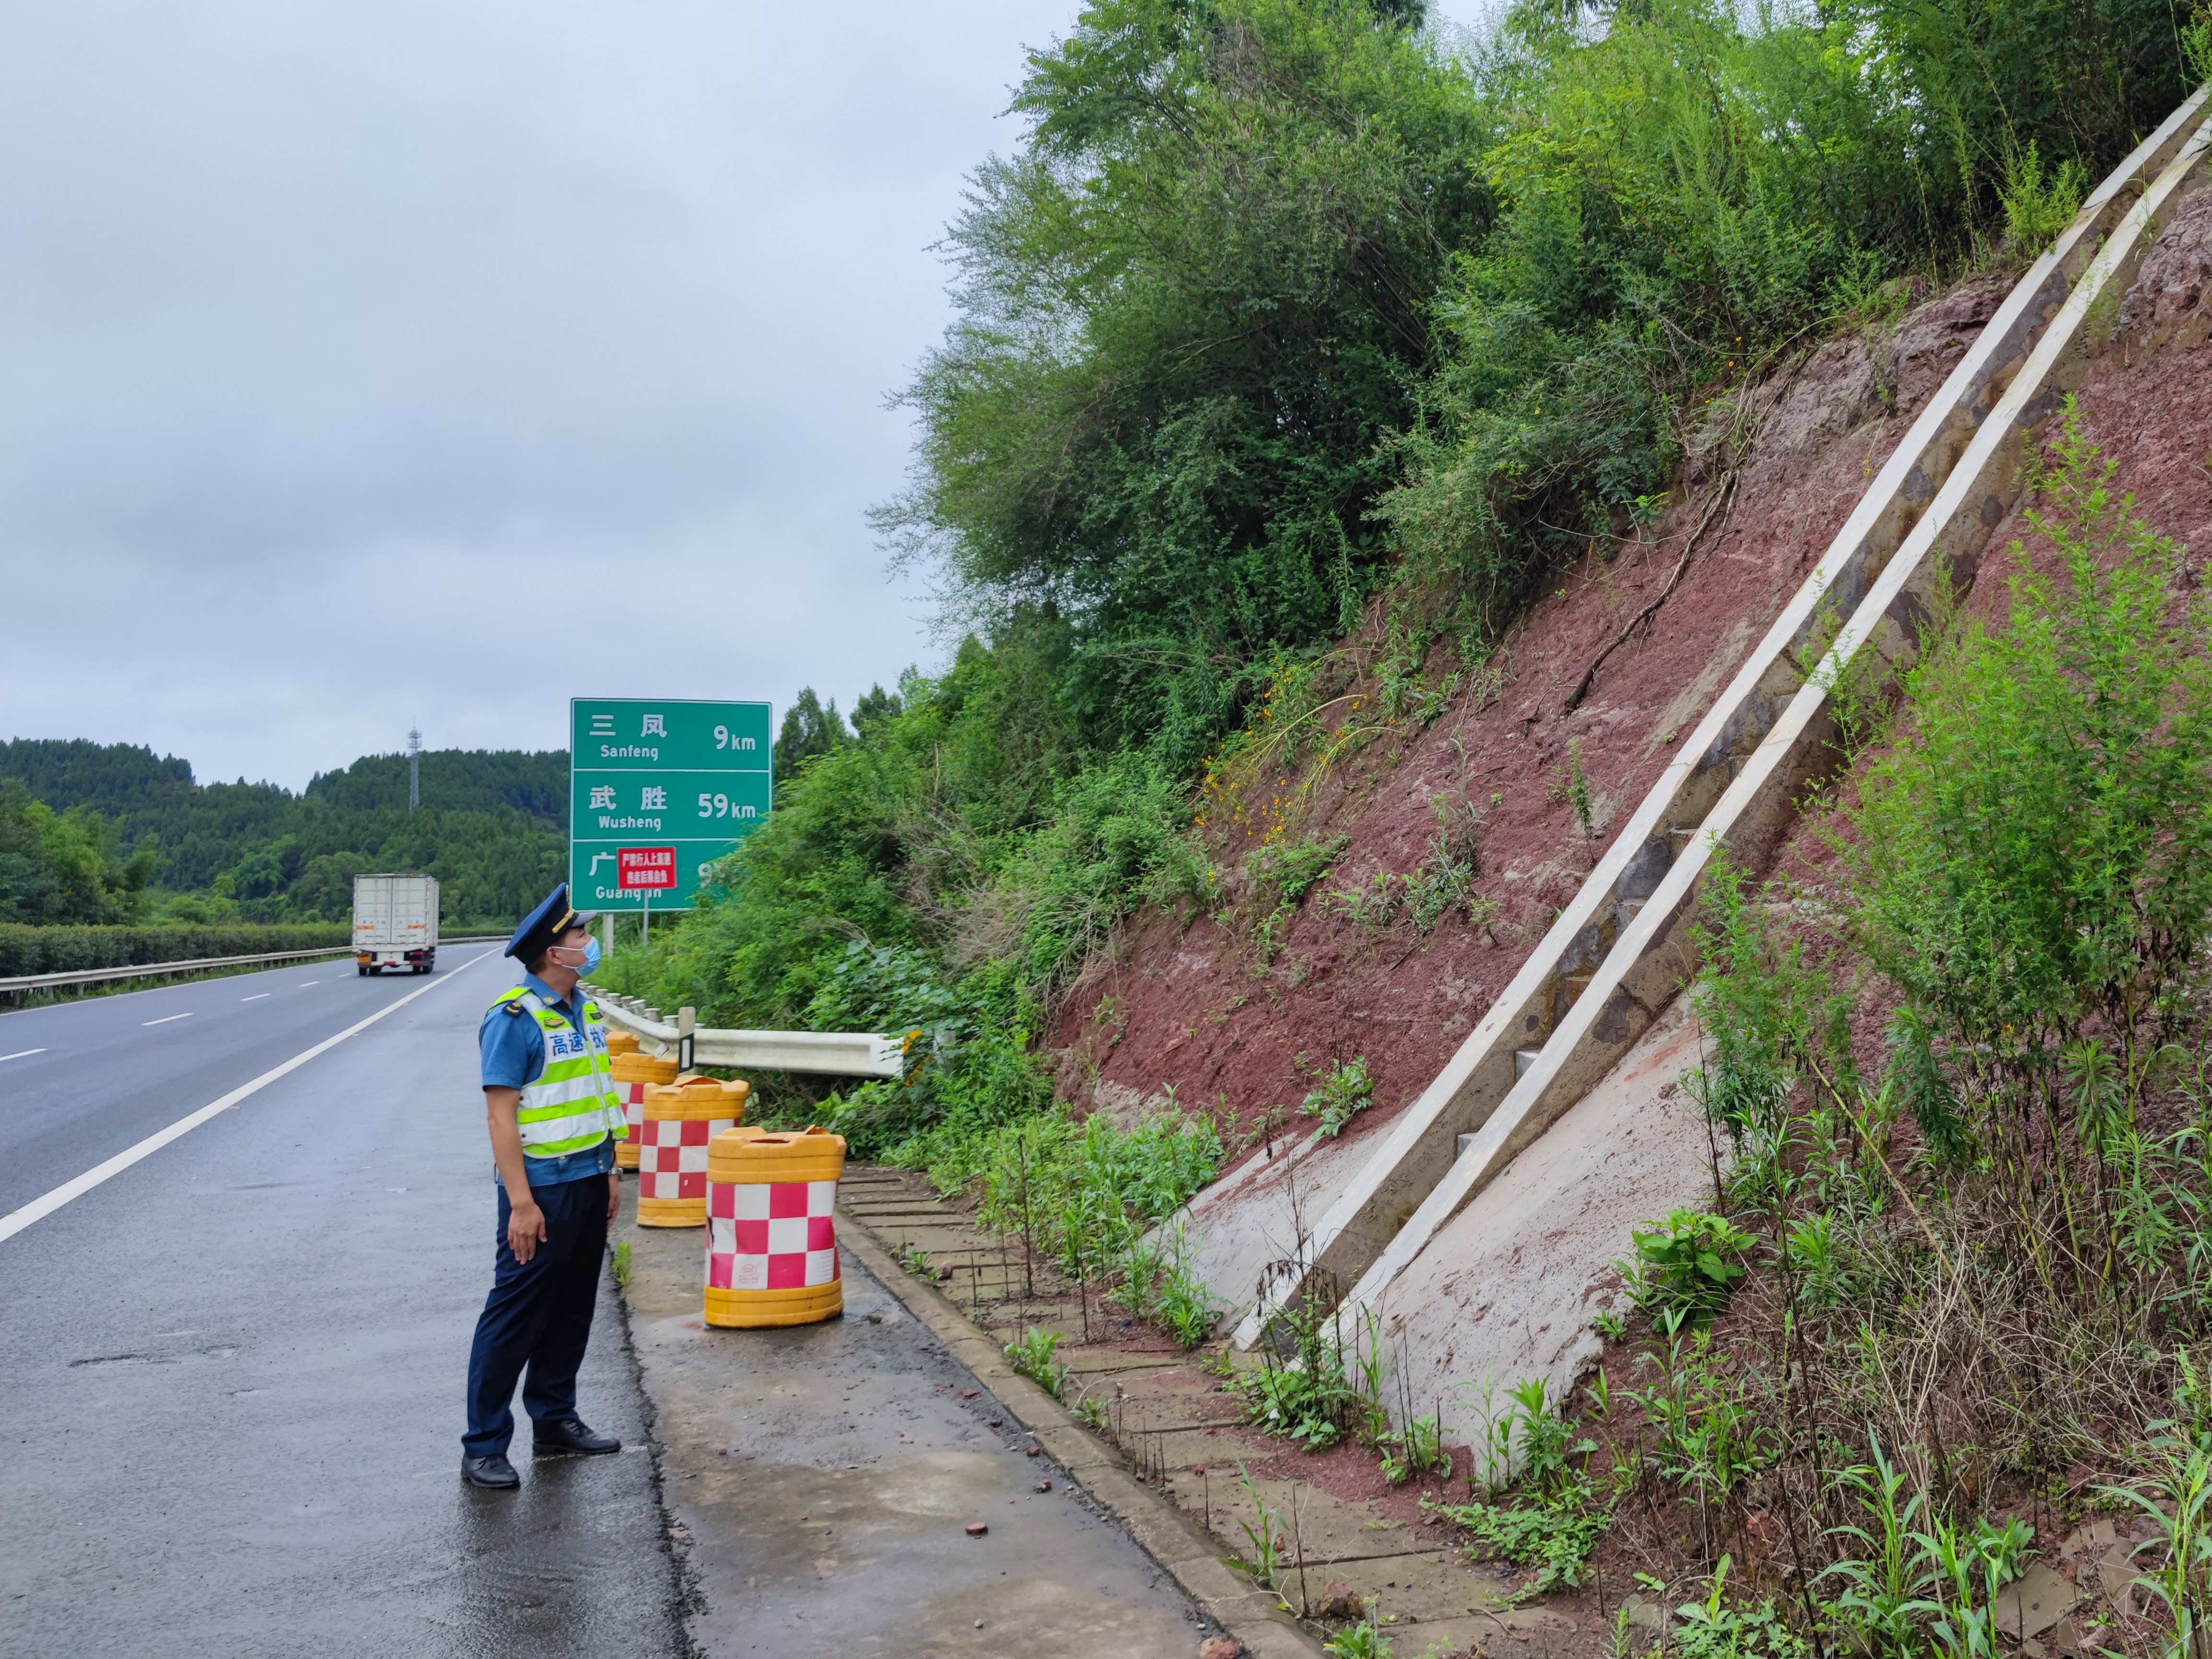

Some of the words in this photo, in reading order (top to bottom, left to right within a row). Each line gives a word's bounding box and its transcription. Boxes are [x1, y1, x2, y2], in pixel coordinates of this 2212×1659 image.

[589, 714, 668, 738] 三凤
[600, 744, 659, 761] Sanfeng
[589, 785, 668, 810] 武胜
[599, 816, 661, 832] Wusheng
[588, 851, 616, 876] 广
